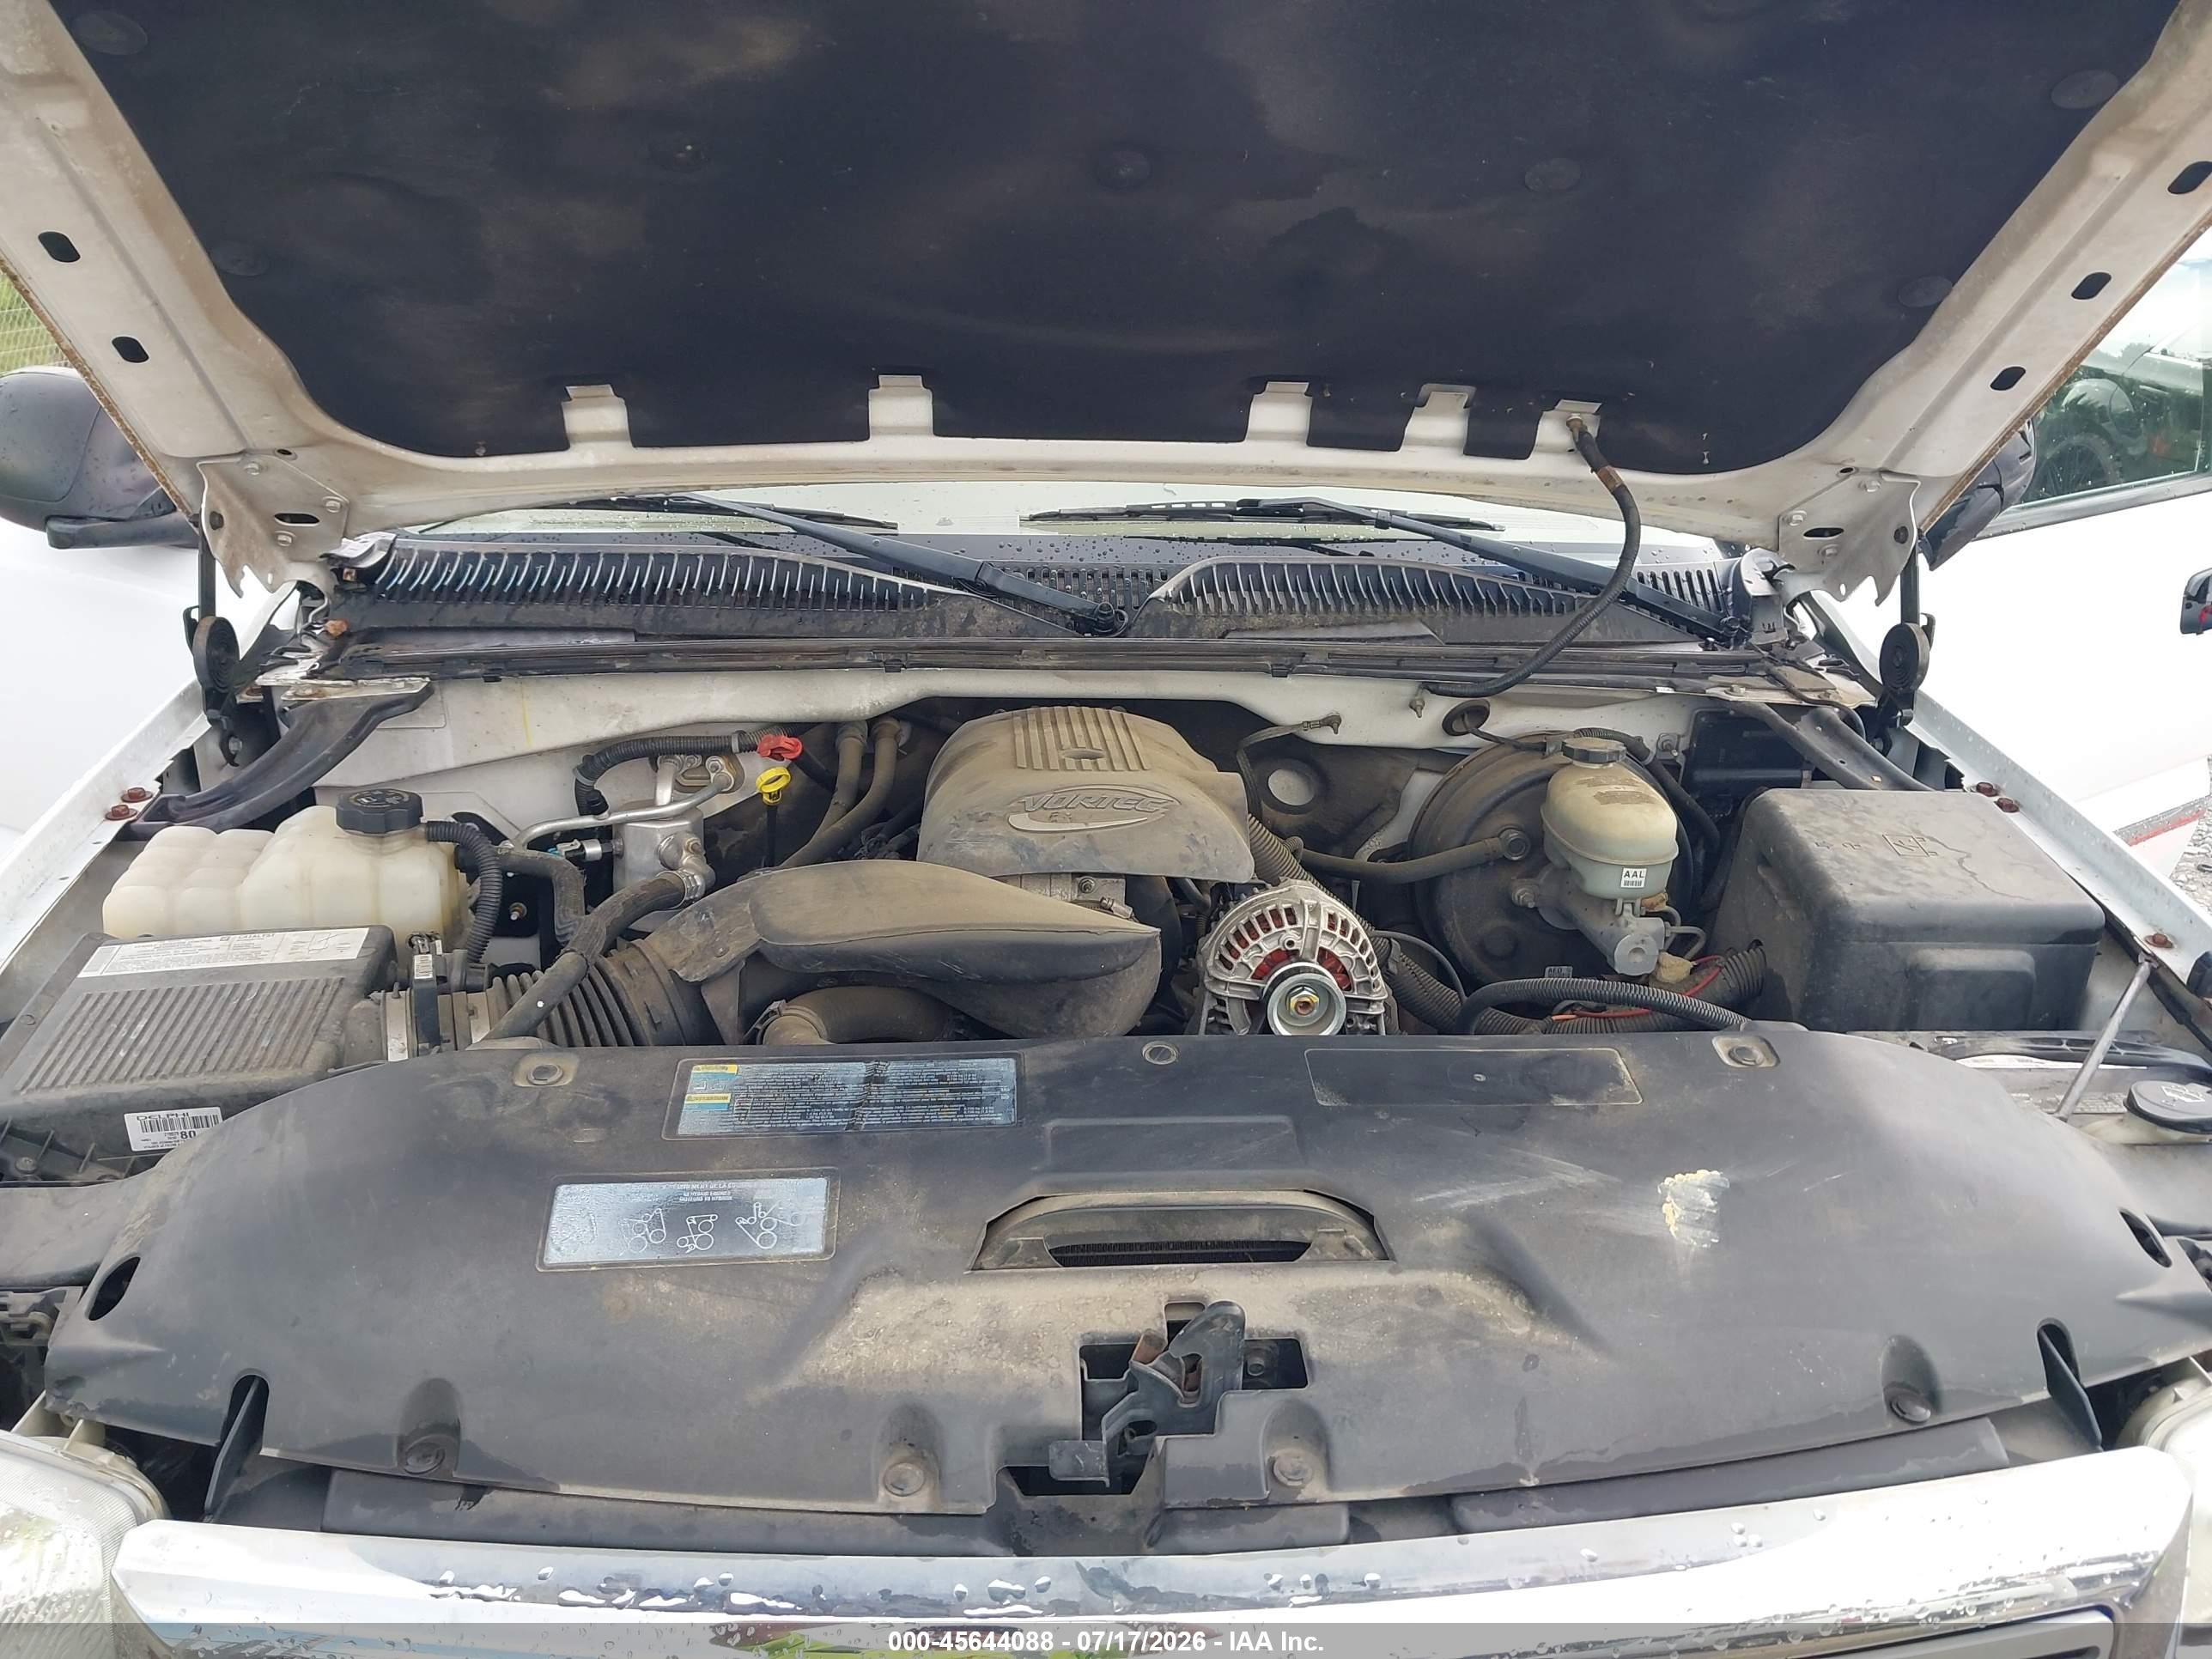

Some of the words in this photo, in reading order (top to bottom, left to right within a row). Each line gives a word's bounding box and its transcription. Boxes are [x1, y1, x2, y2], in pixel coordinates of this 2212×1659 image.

[1019, 795, 1168, 812] VORTEC
[137, 1112, 189, 1121] DELPHI
[180, 1130, 197, 1139] 80
